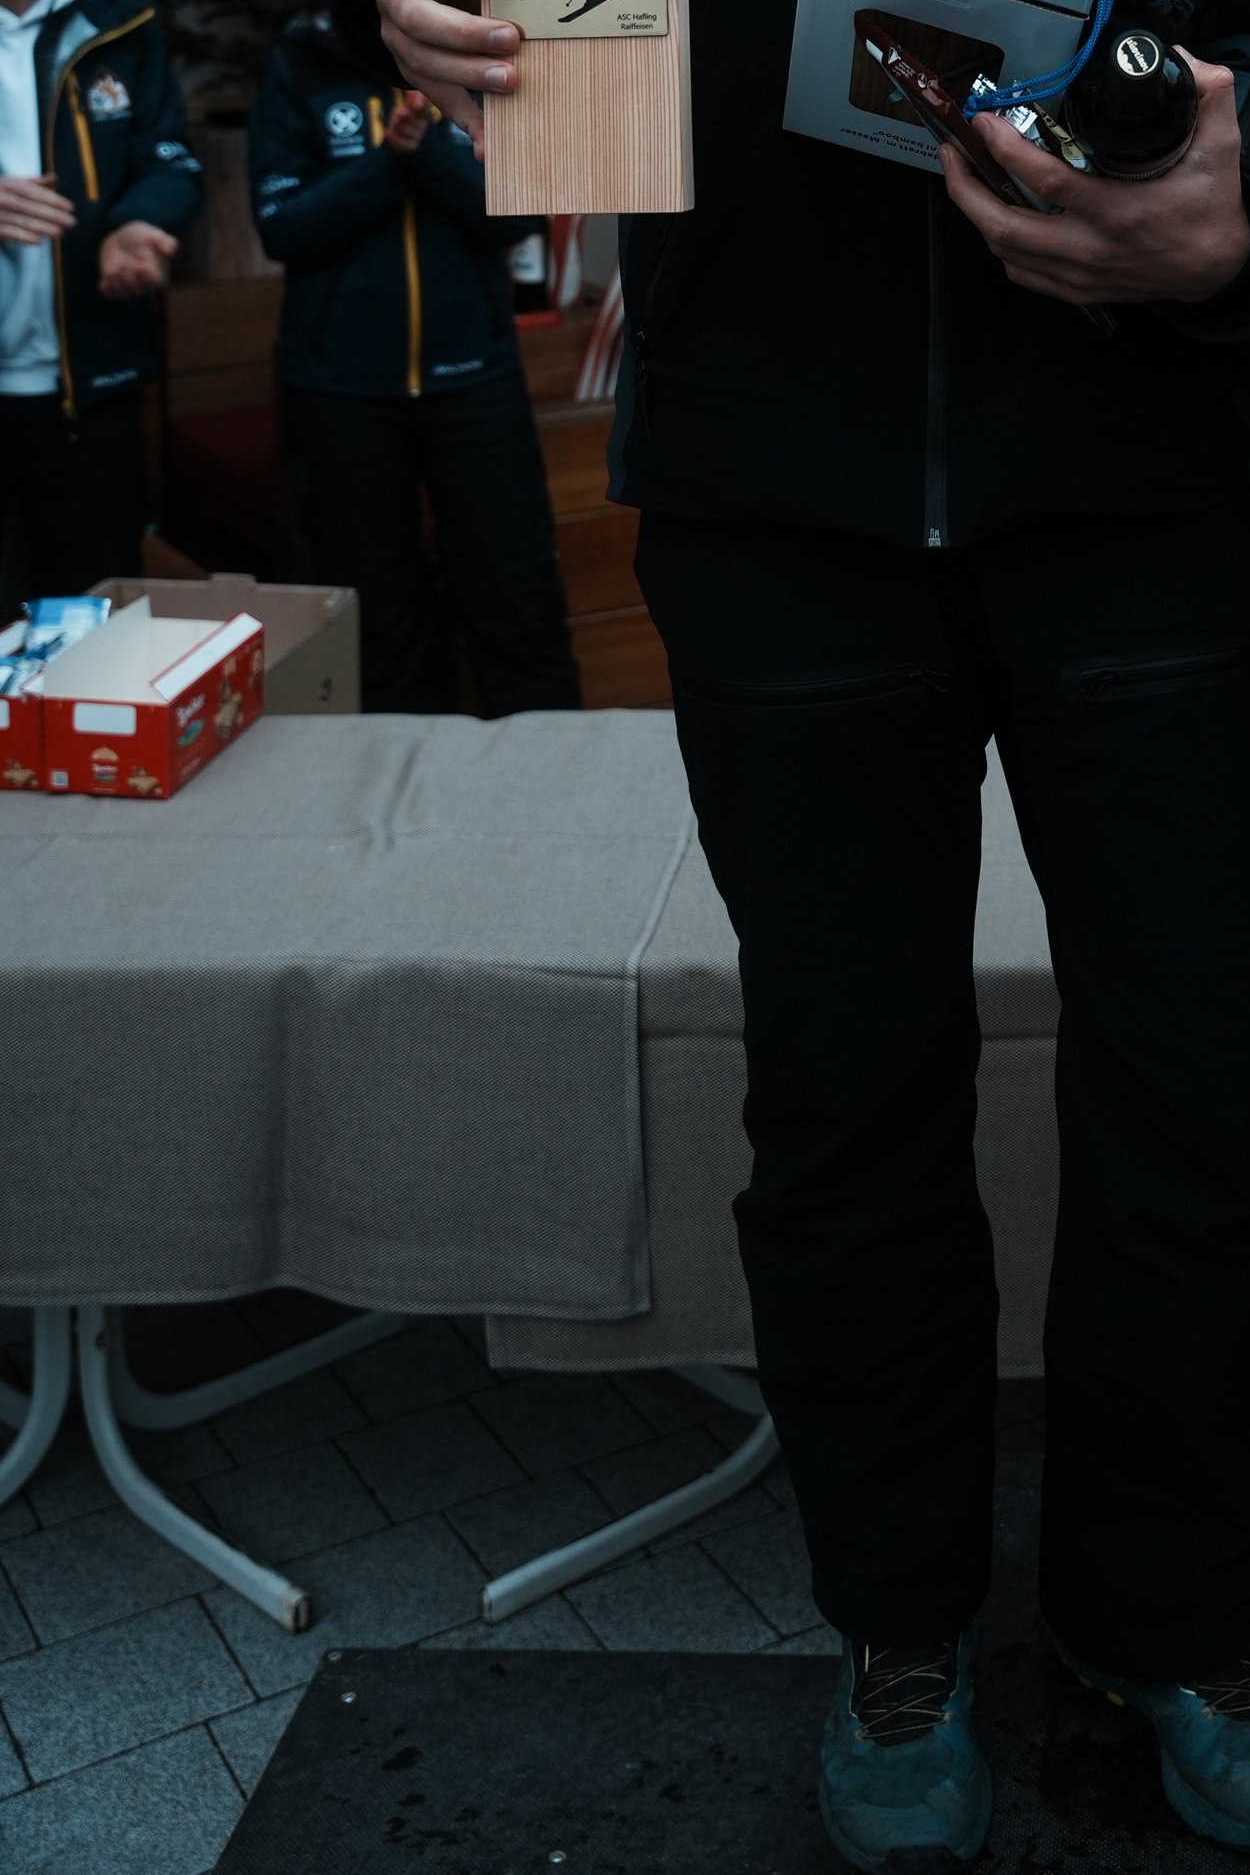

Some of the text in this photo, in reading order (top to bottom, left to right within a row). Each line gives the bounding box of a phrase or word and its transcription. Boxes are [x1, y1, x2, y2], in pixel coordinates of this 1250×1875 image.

[617, 13, 657, 22] ASC Hafling
[840, 127, 880, 144] Messer
[899, 144, 938, 161] debrett
